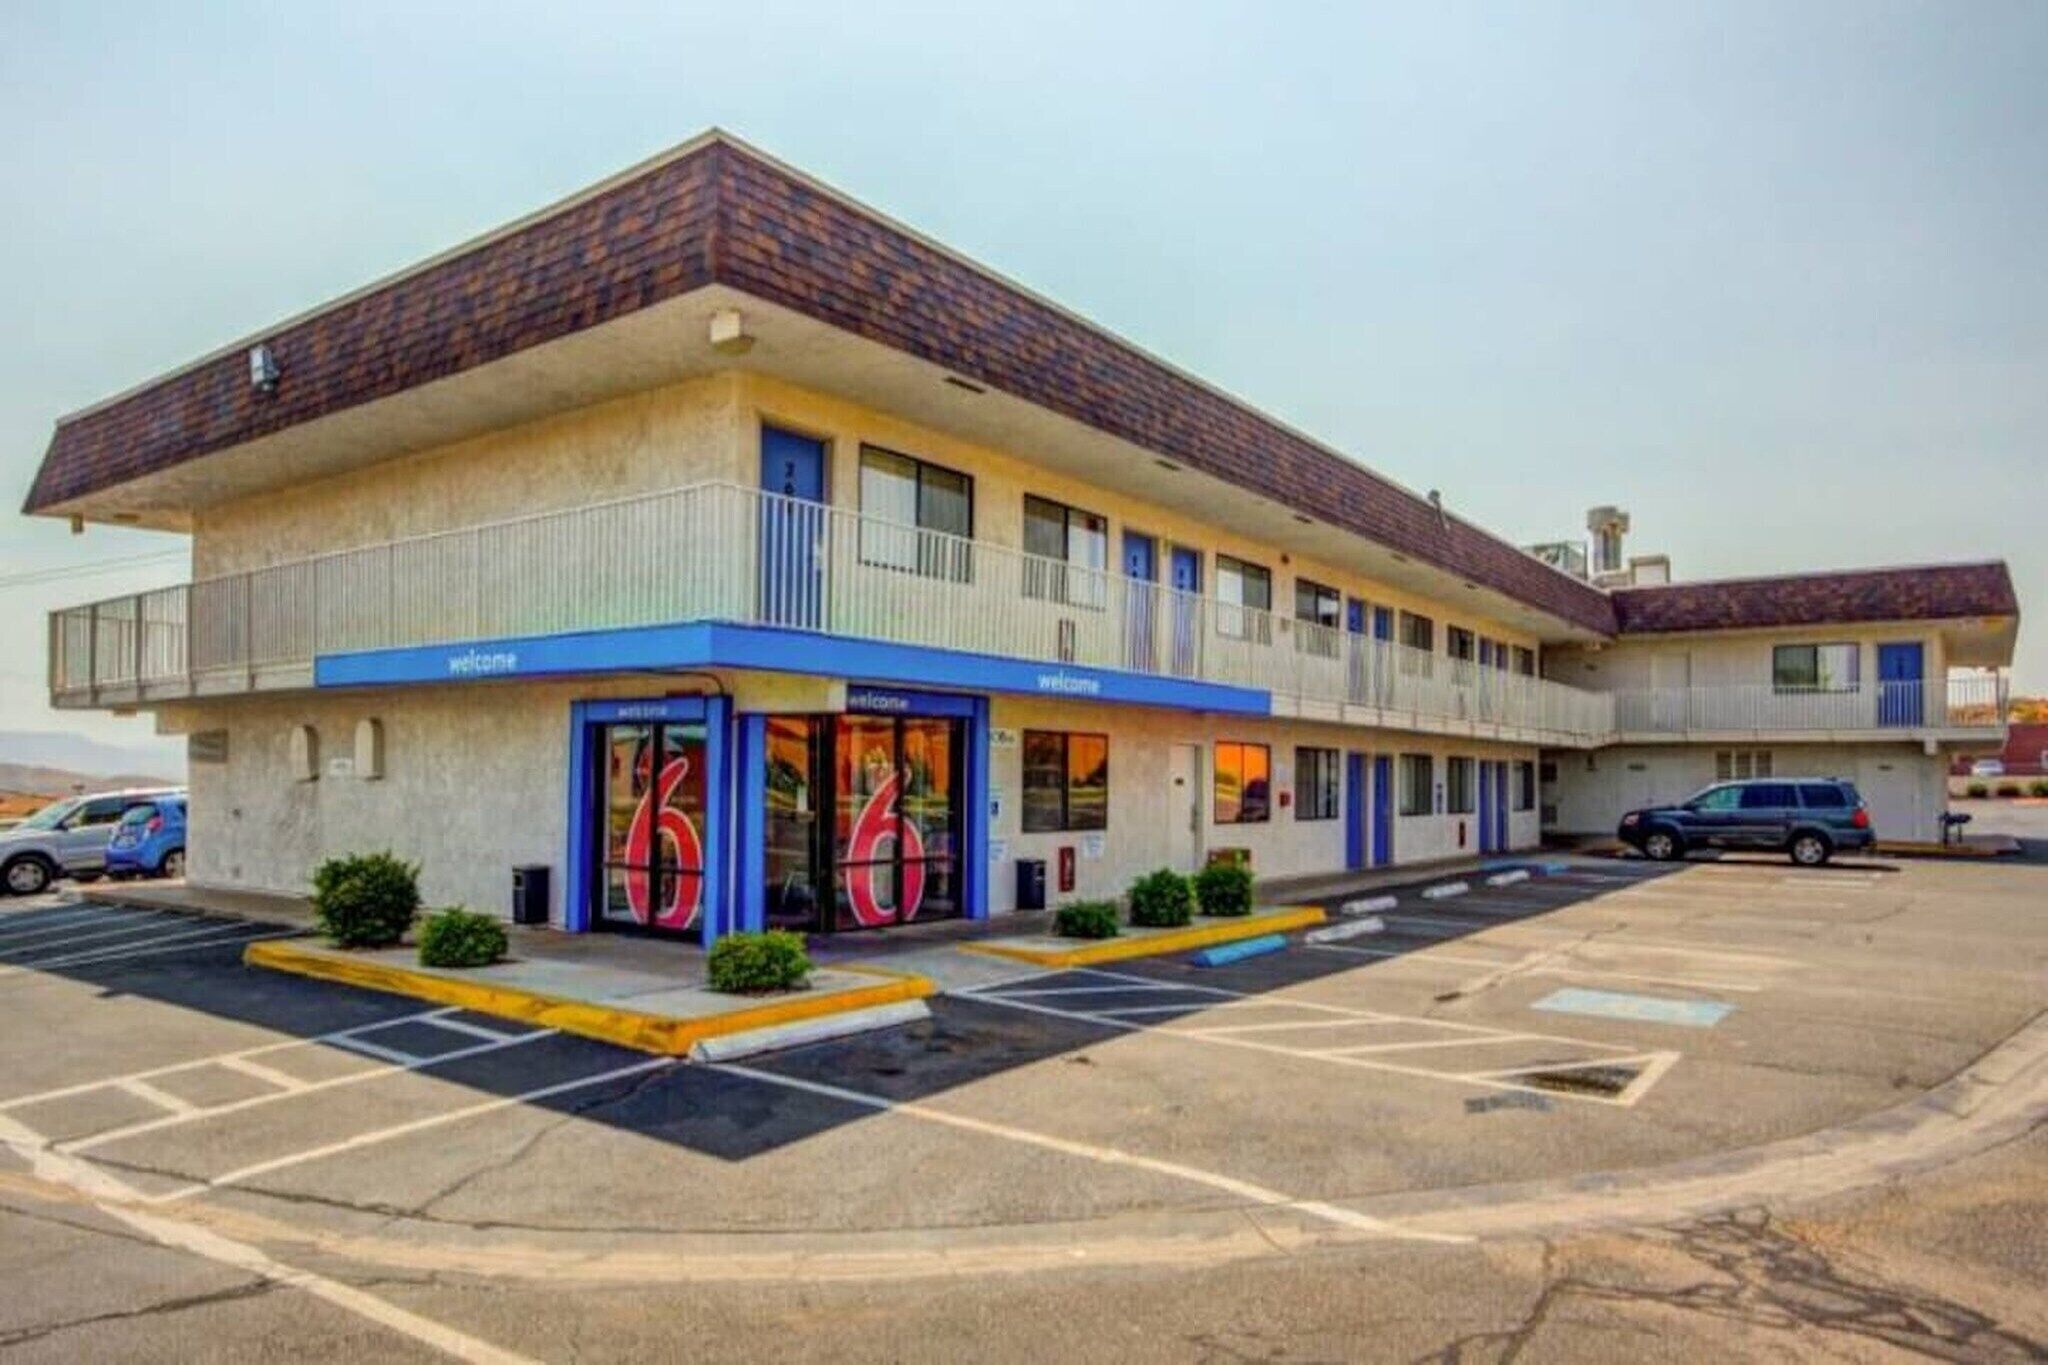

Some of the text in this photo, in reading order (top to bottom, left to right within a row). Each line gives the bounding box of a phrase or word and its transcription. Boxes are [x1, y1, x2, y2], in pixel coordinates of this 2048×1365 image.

[449, 648, 517, 674] welcome
[1038, 668, 1099, 695] welcome
[625, 757, 703, 930] 6
[846, 764, 925, 927] 6
